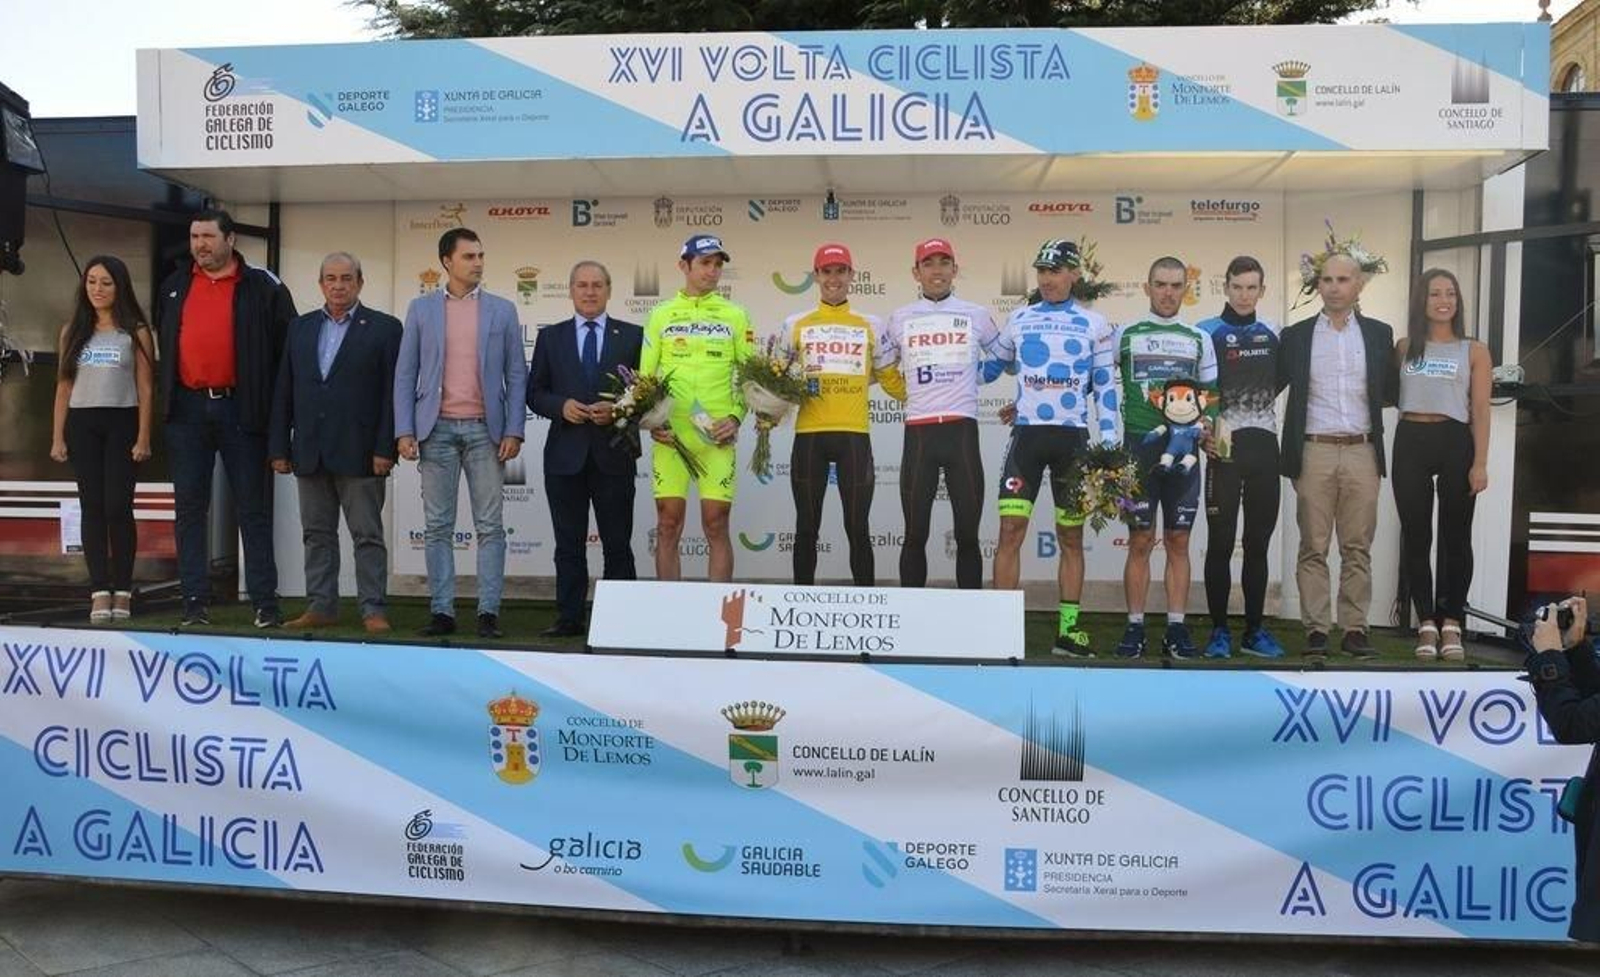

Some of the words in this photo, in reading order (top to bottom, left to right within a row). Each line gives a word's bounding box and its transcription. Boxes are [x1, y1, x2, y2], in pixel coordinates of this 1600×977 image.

[609, 46, 682, 83] XVI
[699, 44, 851, 82] VOLTA
[868, 43, 1070, 81] CICLISTA
[338, 90, 390, 102] DEPORTE
[444, 91, 480, 101] XUNTA
[482, 90, 496, 100] DE
[498, 89, 542, 100] GALICIA
[1172, 83, 1231, 94] MONFORTE
[1315, 84, 1358, 95] CONCELLO
[1361, 84, 1372, 94] DE
[337, 101, 385, 112] GALEGO
[1174, 94, 1192, 105] DE
[205, 101, 274, 117] FEDERACIÓN
[680, 92, 720, 142] A
[742, 91, 995, 141] GALICIA
[1439, 107, 1487, 120] CONCELLO
[1490, 106, 1503, 119] DE
[205, 117, 253, 133] GALEGA
[257, 117, 273, 132] DE
[1446, 118, 1495, 130] SANTIAGO
[206, 133, 274, 151] CICLISMO
[488, 205, 550, 217] anova
[1029, 202, 1094, 212] anova
[1191, 199, 1260, 213] telefurgo
[686, 213, 723, 226] LUGO
[973, 213, 1011, 225] LUGO
[909, 332, 967, 348] FROIZ
[805, 341, 863, 356] FROIZ
[1024, 375, 1080, 387] telefurgo
[784, 591, 865, 606] CONCELLO
[868, 593, 888, 606] DE
[769, 606, 900, 630] MONFORTE
[774, 629, 808, 650] DE
[815, 630, 895, 651] LEMOS
[3, 642, 106, 699] XVI
[129, 649, 336, 711] VOLTA
[566, 715, 627, 729] CONCELLO
[629, 718, 645, 730] DE
[1272, 688, 1393, 744] XVI
[1418, 688, 1560, 745] VOL
[558, 729, 655, 750] MONFORTE
[34, 725, 302, 792] CICLISTA
[563, 746, 590, 763] DE
[594, 747, 652, 766] LEMOS
[792, 745, 866, 762] CONCELLO
[870, 747, 888, 762] DE
[893, 745, 935, 763] LALÍN
[792, 766, 876, 782] www.lalin.gal
[998, 787, 1079, 806] CONCELLO
[1085, 789, 1105, 805] DE
[1307, 773, 1570, 834] CICLIST
[1011, 806, 1090, 824] SANTIAGO
[13, 805, 52, 857] A
[73, 808, 324, 874] GALICIA
[406, 841, 463, 856] FEDERACIÓN
[530, 832, 642, 866] galicia
[741, 845, 803, 861] GALICIA
[905, 842, 977, 856] DEPORTE
[407, 854, 448, 868] GALEGA
[450, 855, 463, 868] DE
[905, 856, 969, 870] GALEGO
[1044, 852, 1093, 867] XUNTA
[1097, 854, 1116, 867] DE
[1119, 855, 1179, 868] GALICIA
[408, 865, 465, 881] CICLISMO
[554, 864, 561, 874] o
[564, 862, 578, 875] bo
[741, 863, 821, 878] SAUDABLE
[1044, 871, 1113, 883] PRESIDENCIA
[1093, 885, 1117, 895] Xeral
[1119, 887, 1140, 898] para
[1151, 887, 1188, 898] Deporte
[1280, 860, 1326, 917] A
[1352, 862, 1569, 923] GALIC
